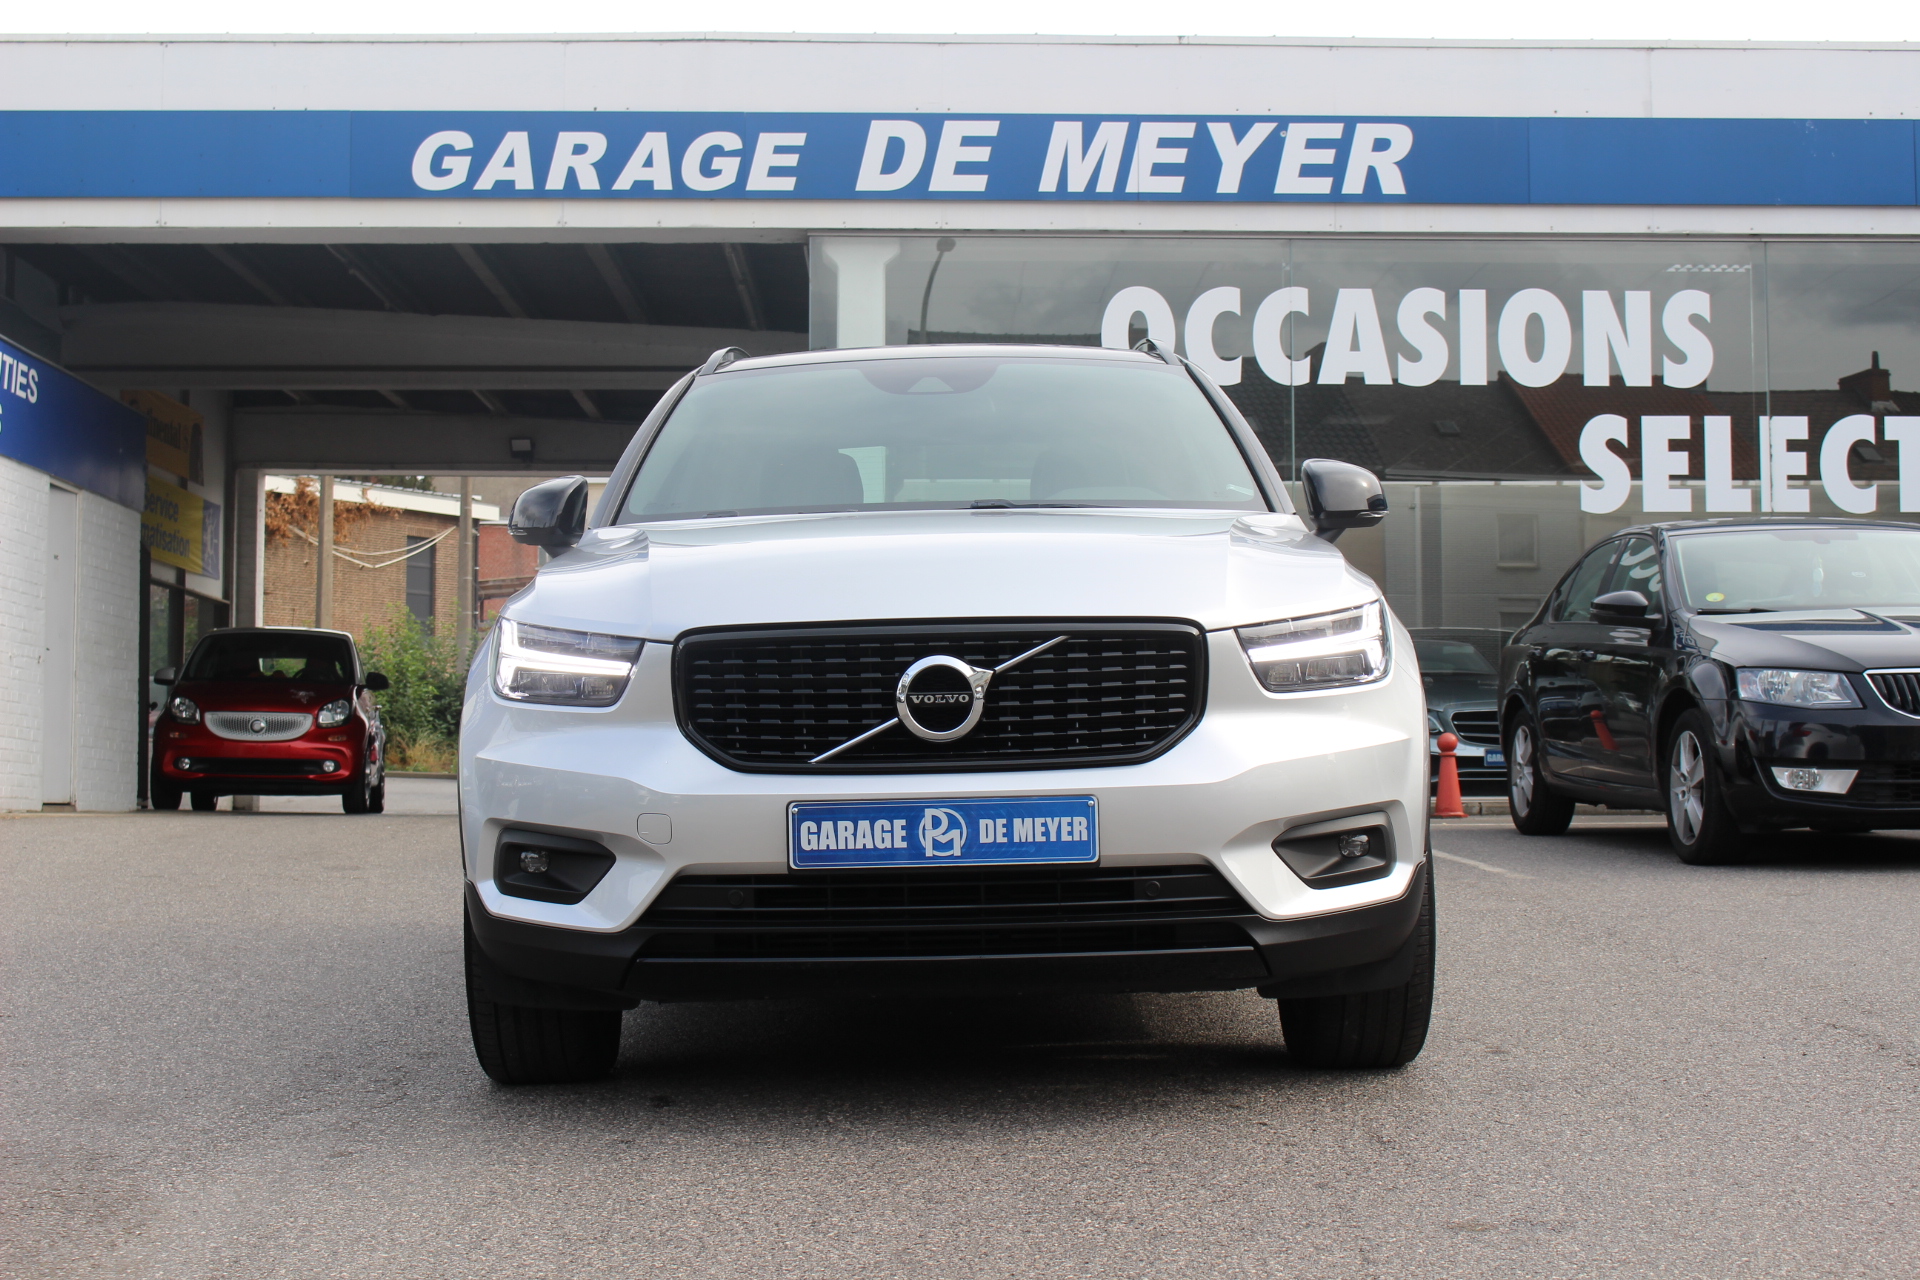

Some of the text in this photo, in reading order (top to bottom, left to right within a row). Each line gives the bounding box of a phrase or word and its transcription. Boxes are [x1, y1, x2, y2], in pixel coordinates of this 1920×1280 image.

[411, 120, 1413, 195] GARAGE DE MEYER
[1101, 286, 1714, 389] OCCASIONS
[1580, 414, 1920, 515] SELECT
[910, 693, 969, 704] VOLVO
[800, 819, 907, 851] GARAGE
[979, 818, 1008, 844] DE
[1013, 816, 1088, 843] MEYER
